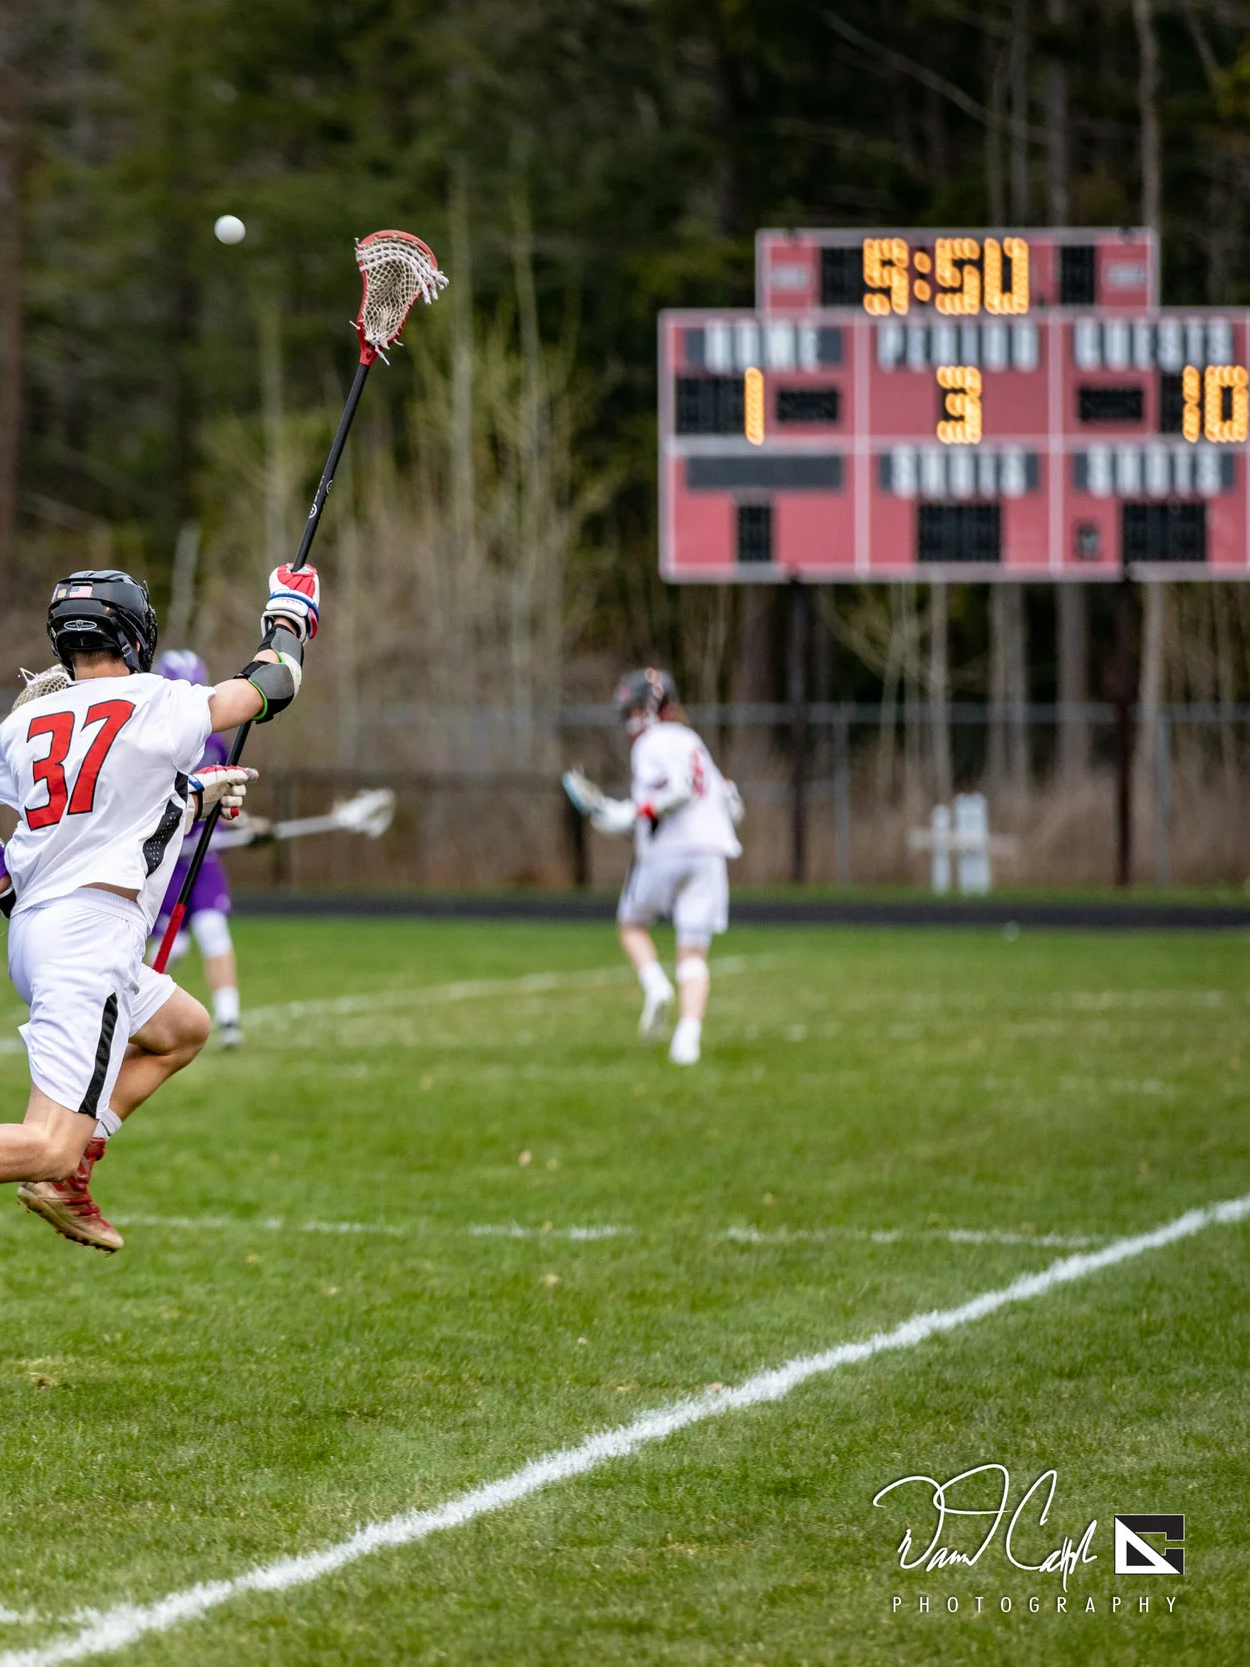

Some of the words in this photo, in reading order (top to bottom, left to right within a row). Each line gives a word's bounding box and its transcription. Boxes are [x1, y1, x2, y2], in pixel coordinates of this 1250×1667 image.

[745, 367, 764, 446] 1
[936, 365, 982, 445] 3
[1182, 364, 1249, 444] 10
[24, 698, 137, 831] 37
